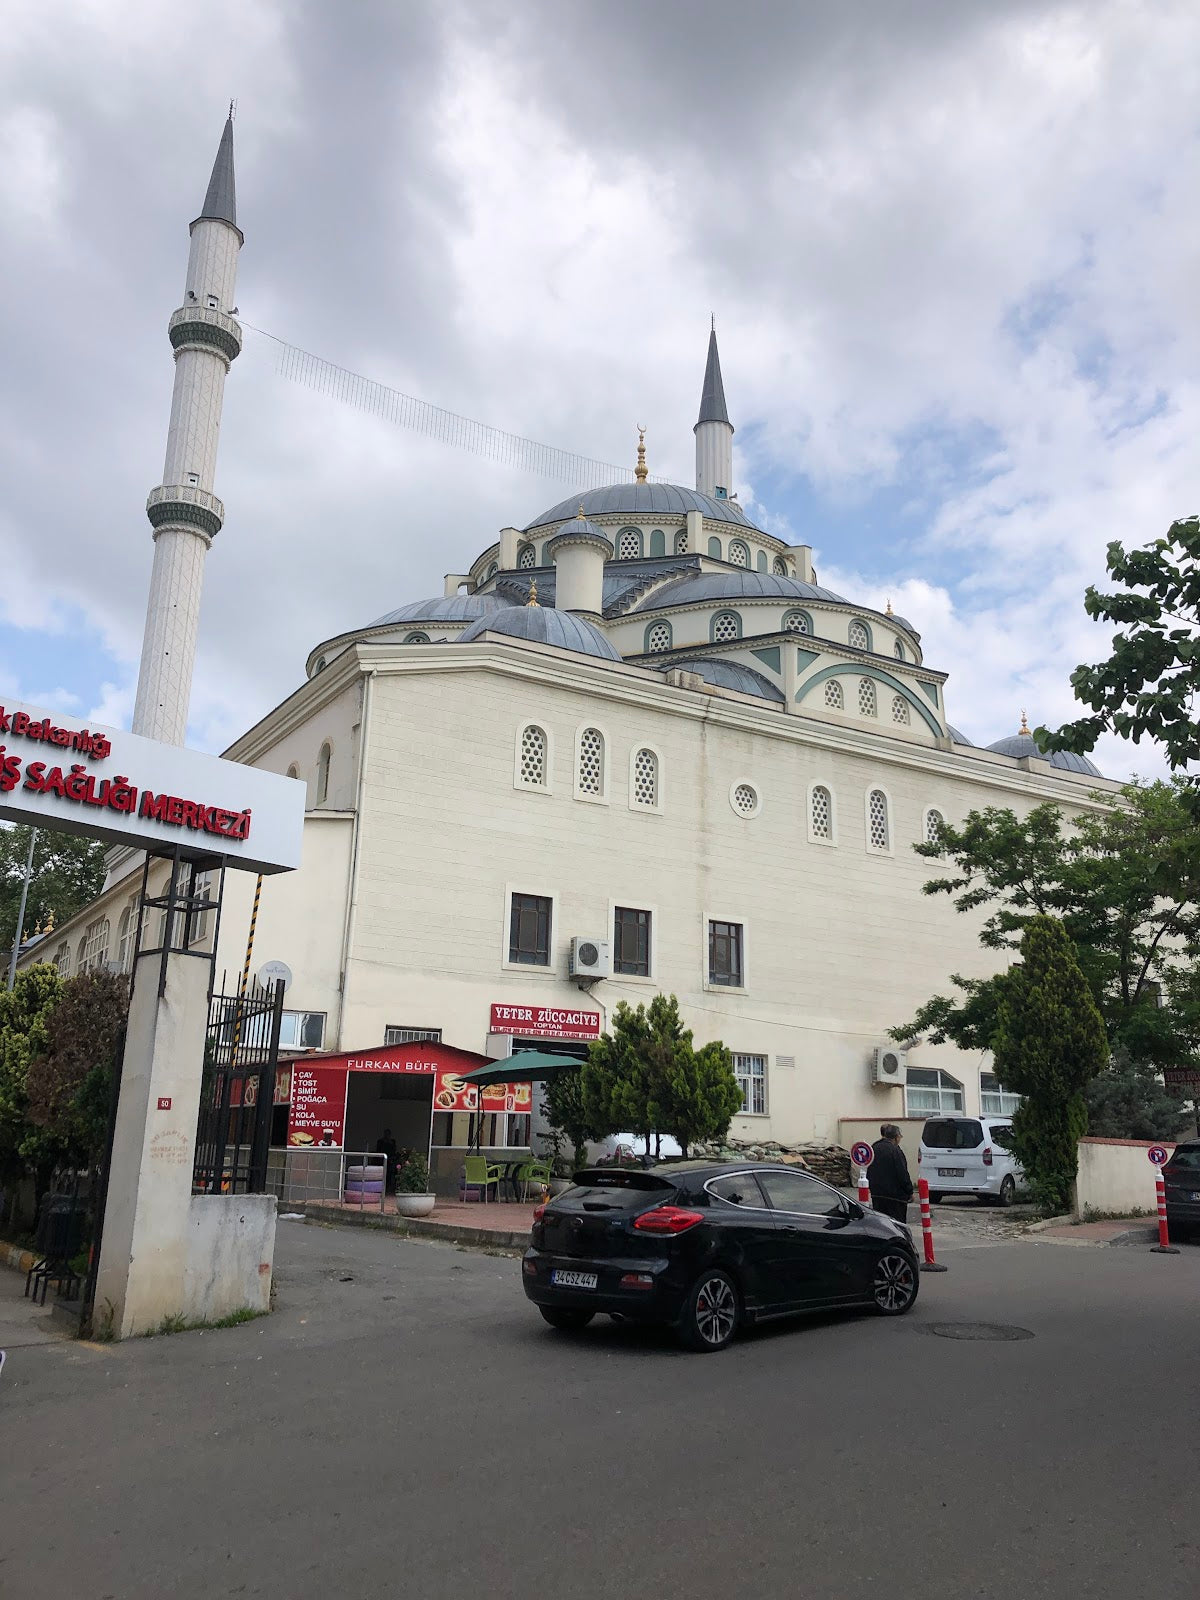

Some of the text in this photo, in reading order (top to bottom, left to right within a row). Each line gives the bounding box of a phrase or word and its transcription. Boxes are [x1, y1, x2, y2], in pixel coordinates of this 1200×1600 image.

[12, 712, 111, 759] Bakanlığı
[24, 762, 138, 813] SAĞLIĞI
[139, 790, 251, 840] MERKEZİ
[495, 1007, 597, 1026] YETER ZÜCCACİYE
[533, 1021, 562, 1030] TOPTAN
[347, 1060, 438, 1071] FURKAN BÜFE
[298, 1071, 314, 1079] ÇAY
[298, 1079, 318, 1087] TOST
[297, 1087, 318, 1095] SİMİT
[297, 1095, 327, 1104] POĞAÇA
[295, 1119, 341, 1128] MEYVE SUYU
[556, 1271, 596, 1288] 34 CSZ 447
